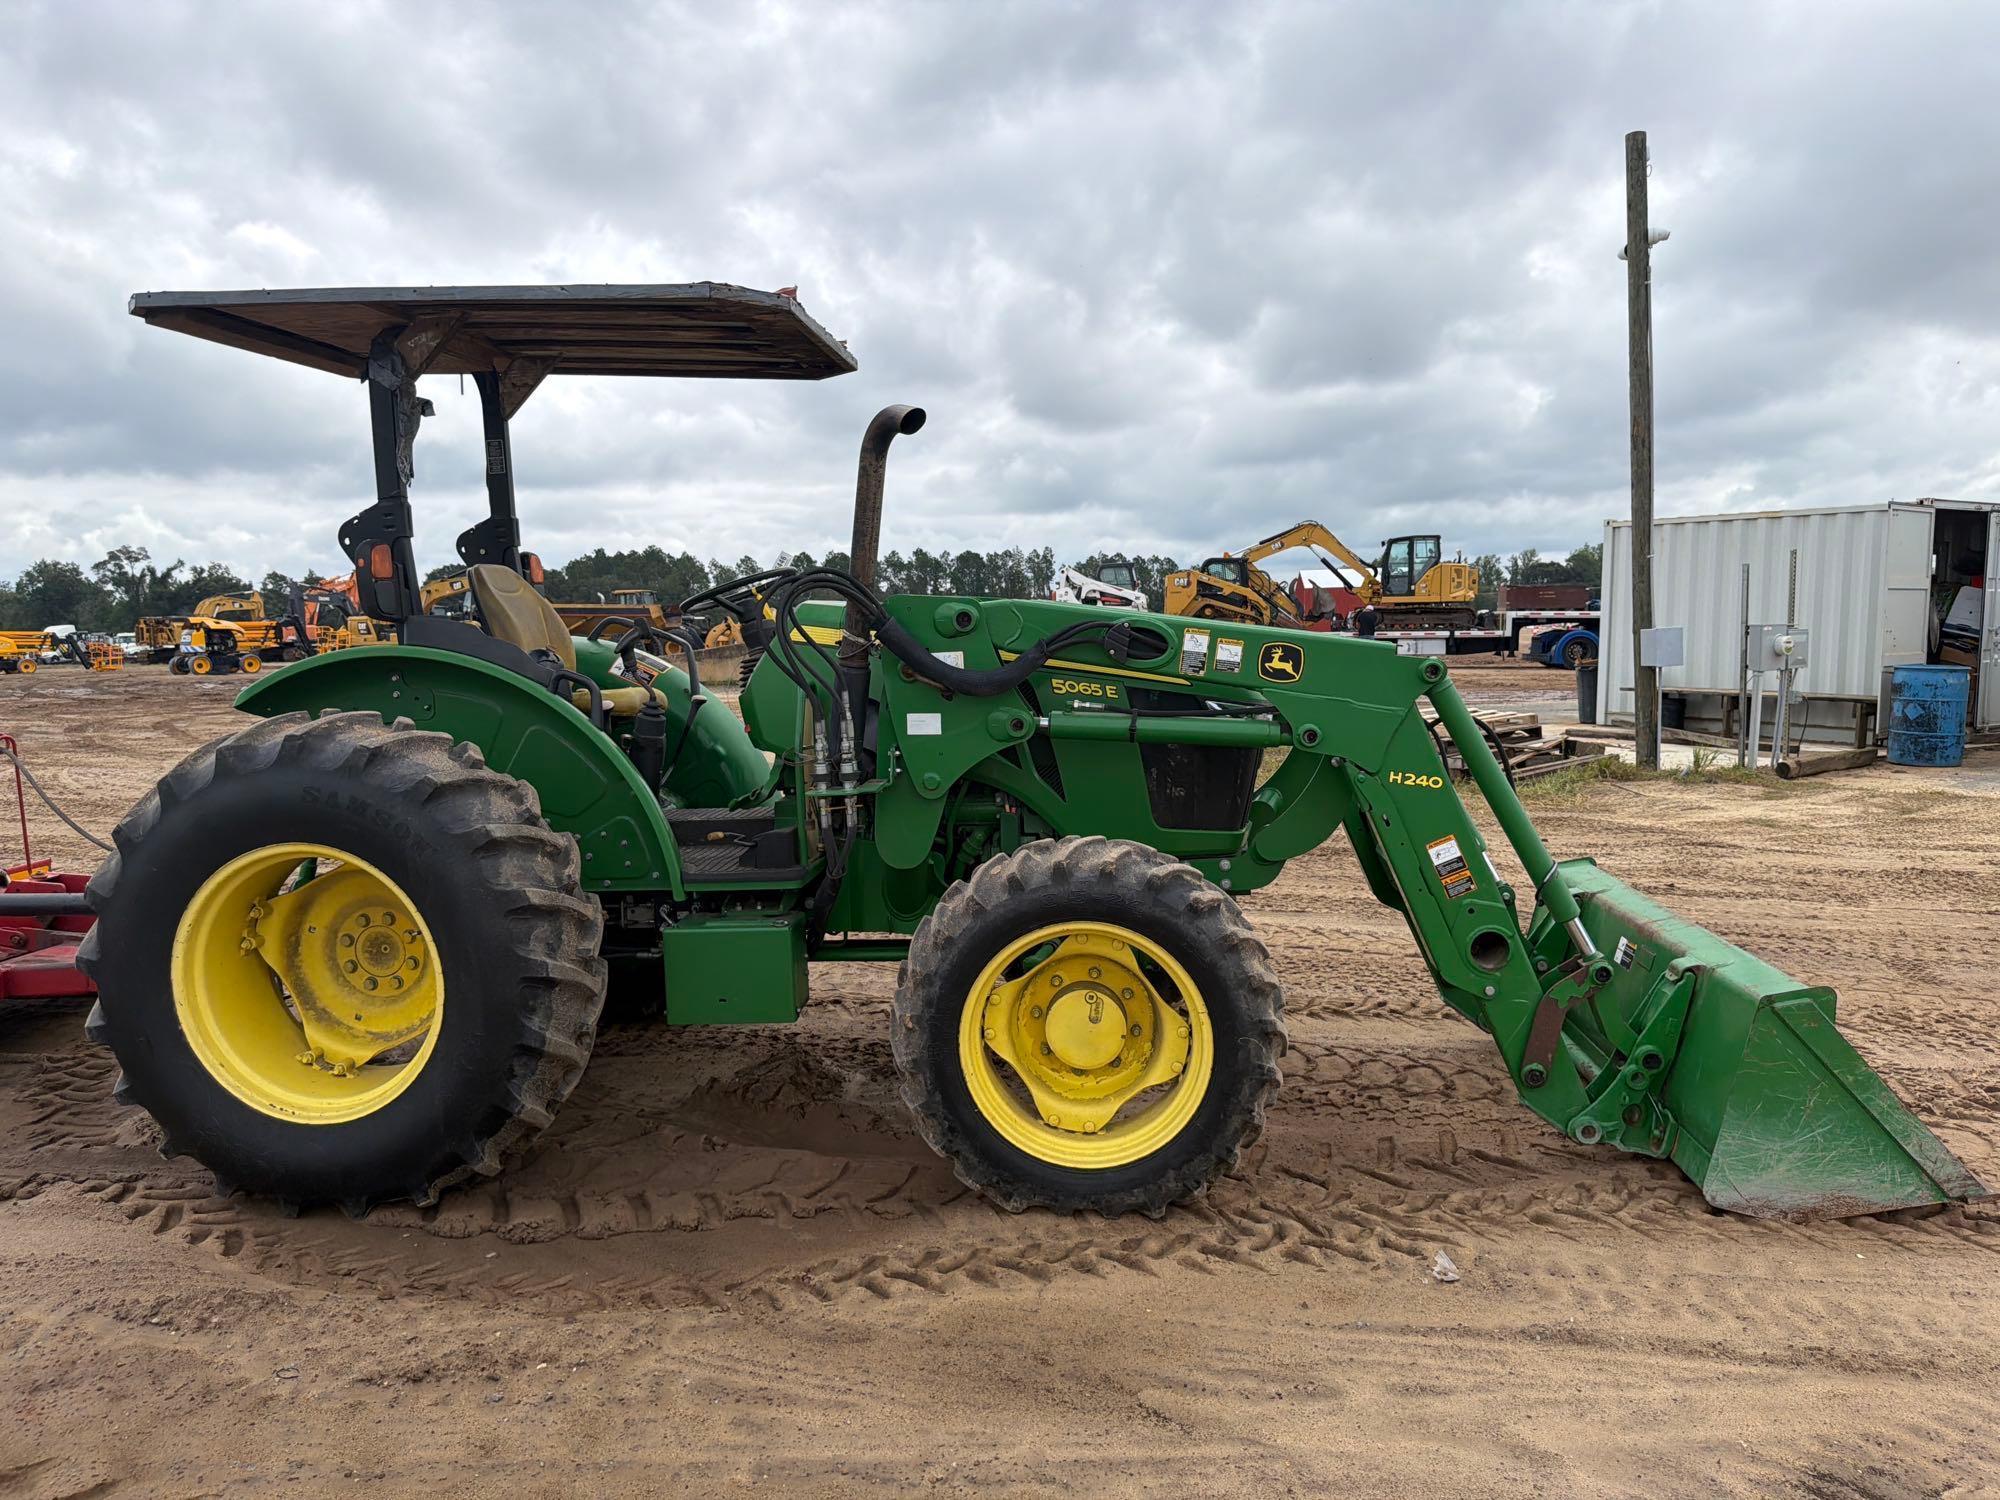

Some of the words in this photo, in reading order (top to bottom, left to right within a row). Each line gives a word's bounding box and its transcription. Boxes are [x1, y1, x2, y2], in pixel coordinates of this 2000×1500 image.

[1271, 541, 1282, 550] CAT
[1174, 578, 1188, 587] CAT
[1051, 678, 1103, 697] 5065
[1105, 685, 1119, 699] E
[1389, 771, 1444, 789] H240
